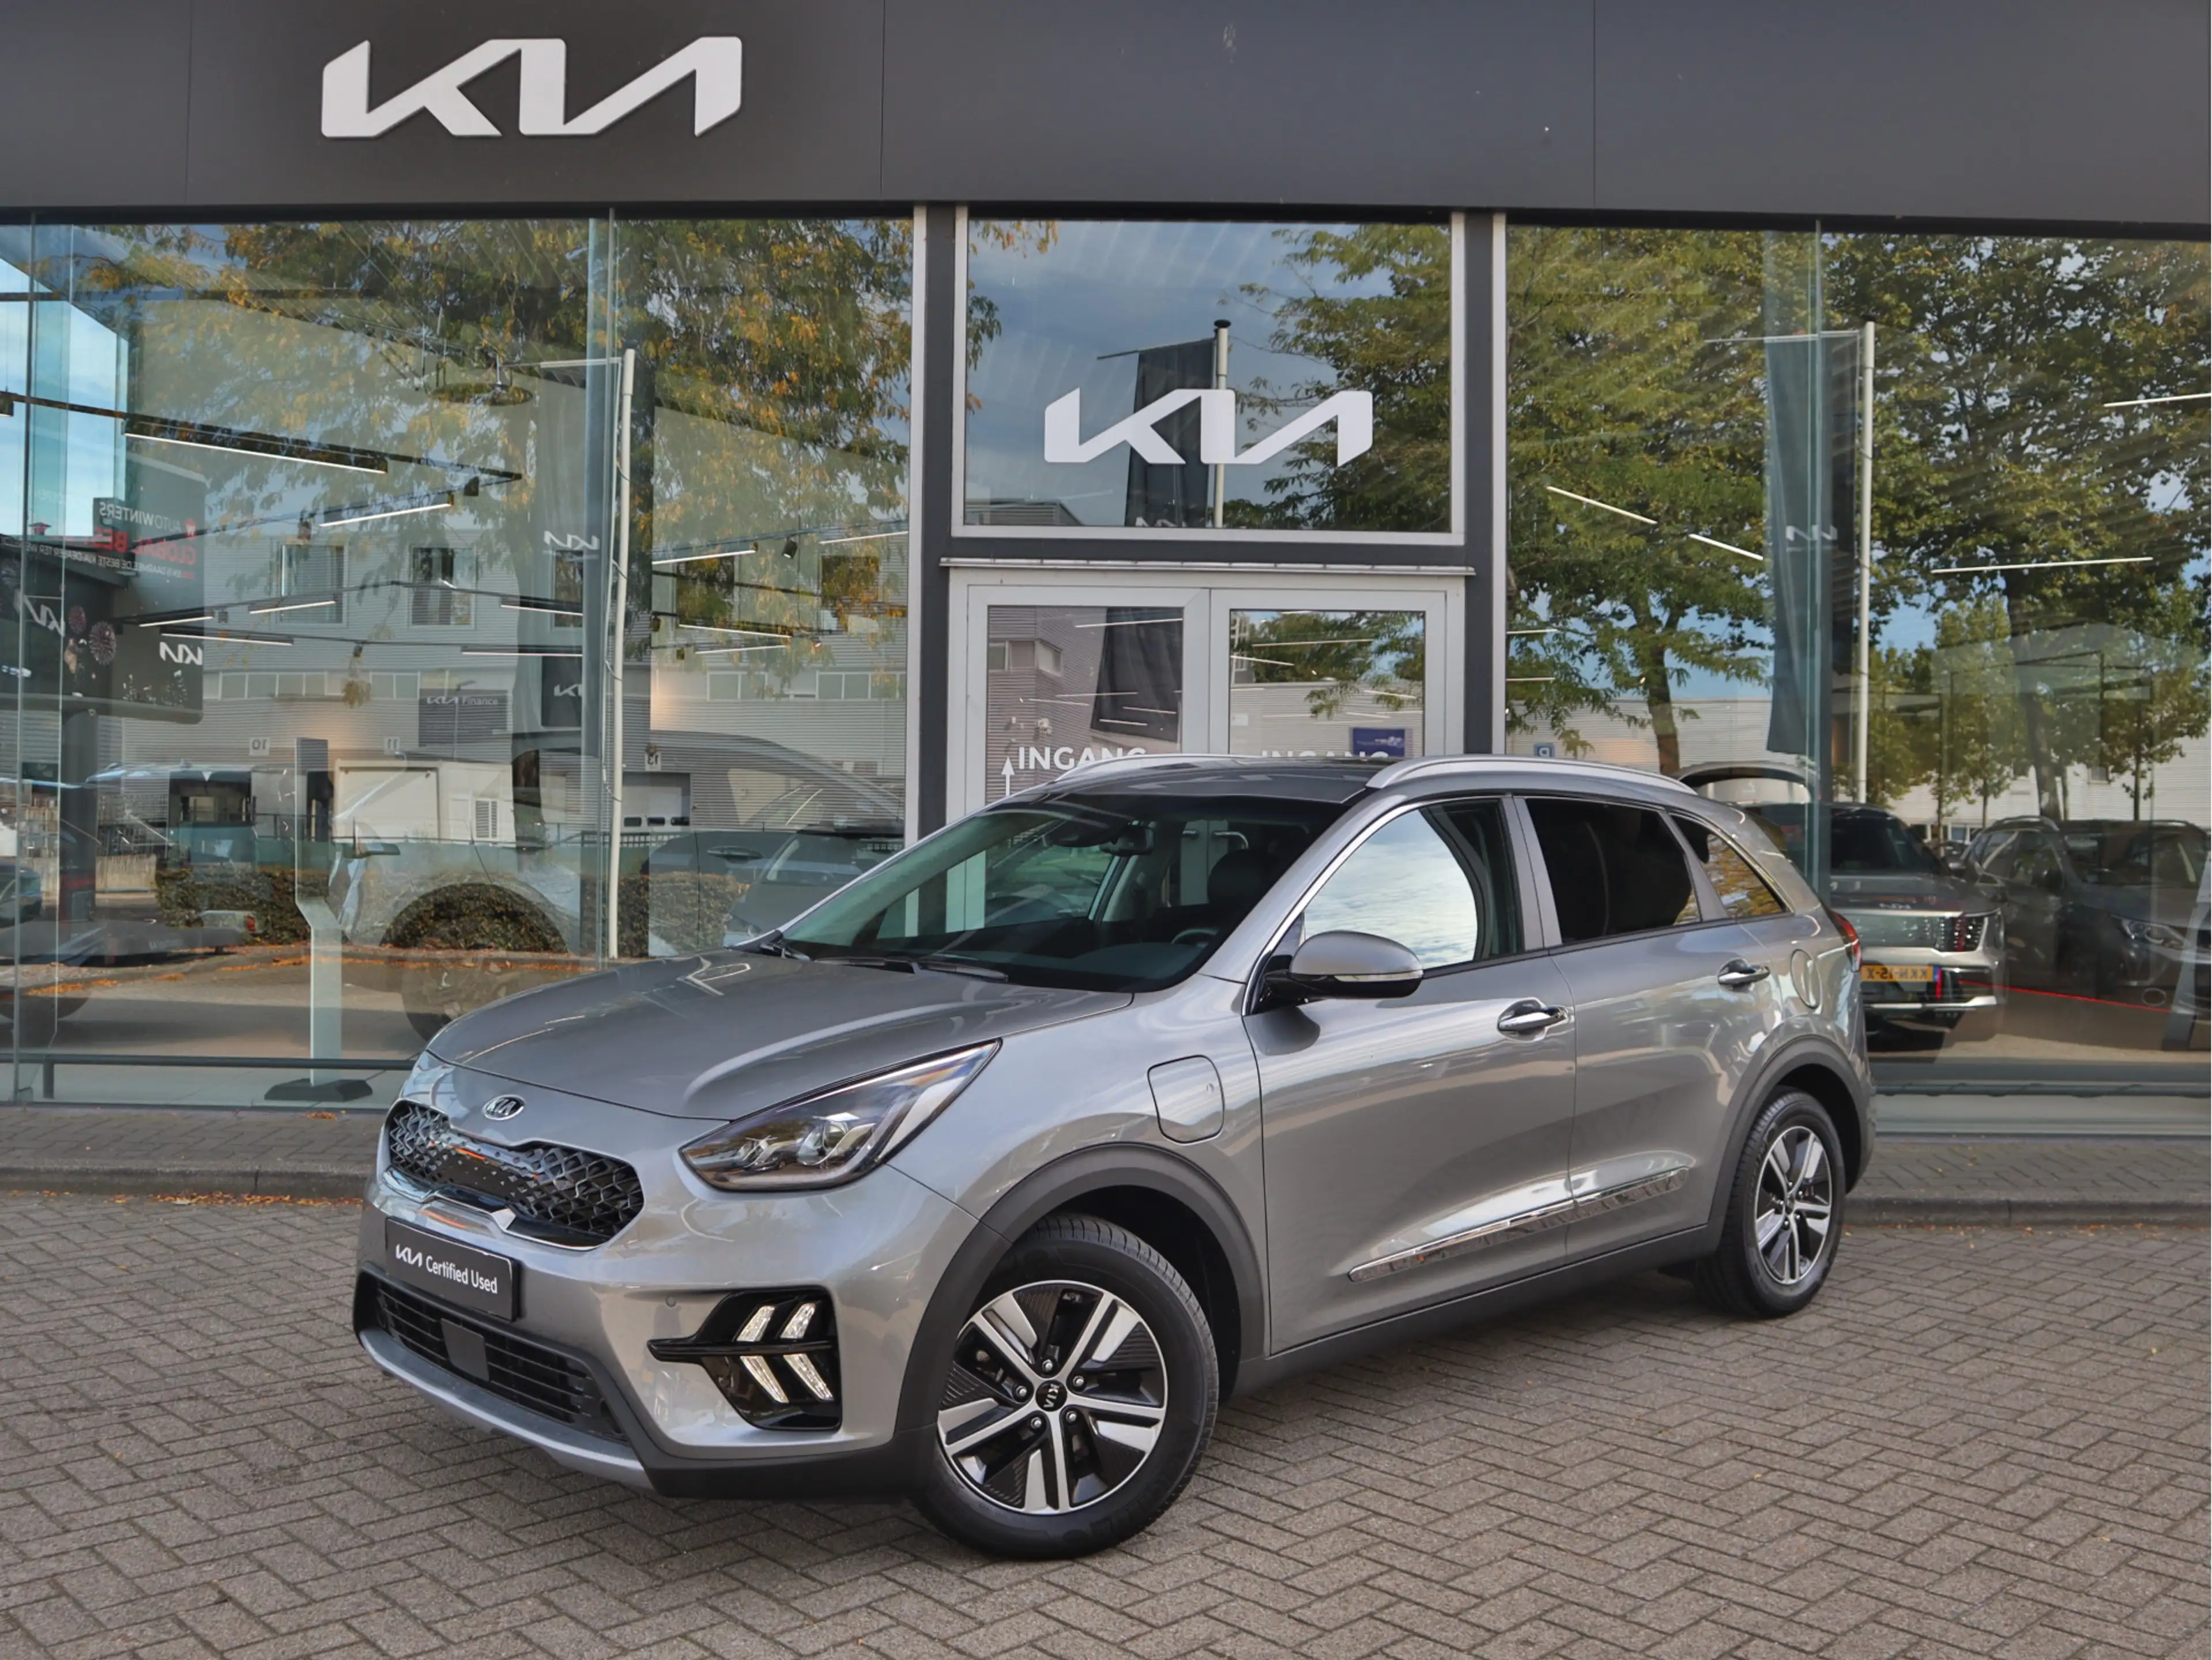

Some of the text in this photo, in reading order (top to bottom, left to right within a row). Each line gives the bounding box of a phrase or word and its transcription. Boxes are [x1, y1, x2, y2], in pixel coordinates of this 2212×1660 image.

[321, 36, 743, 137] KIA
[1044, 387, 1373, 466] KIA
[462, 696, 499, 705] Finance
[395, 1244, 498, 1294] KIA Certified Used
